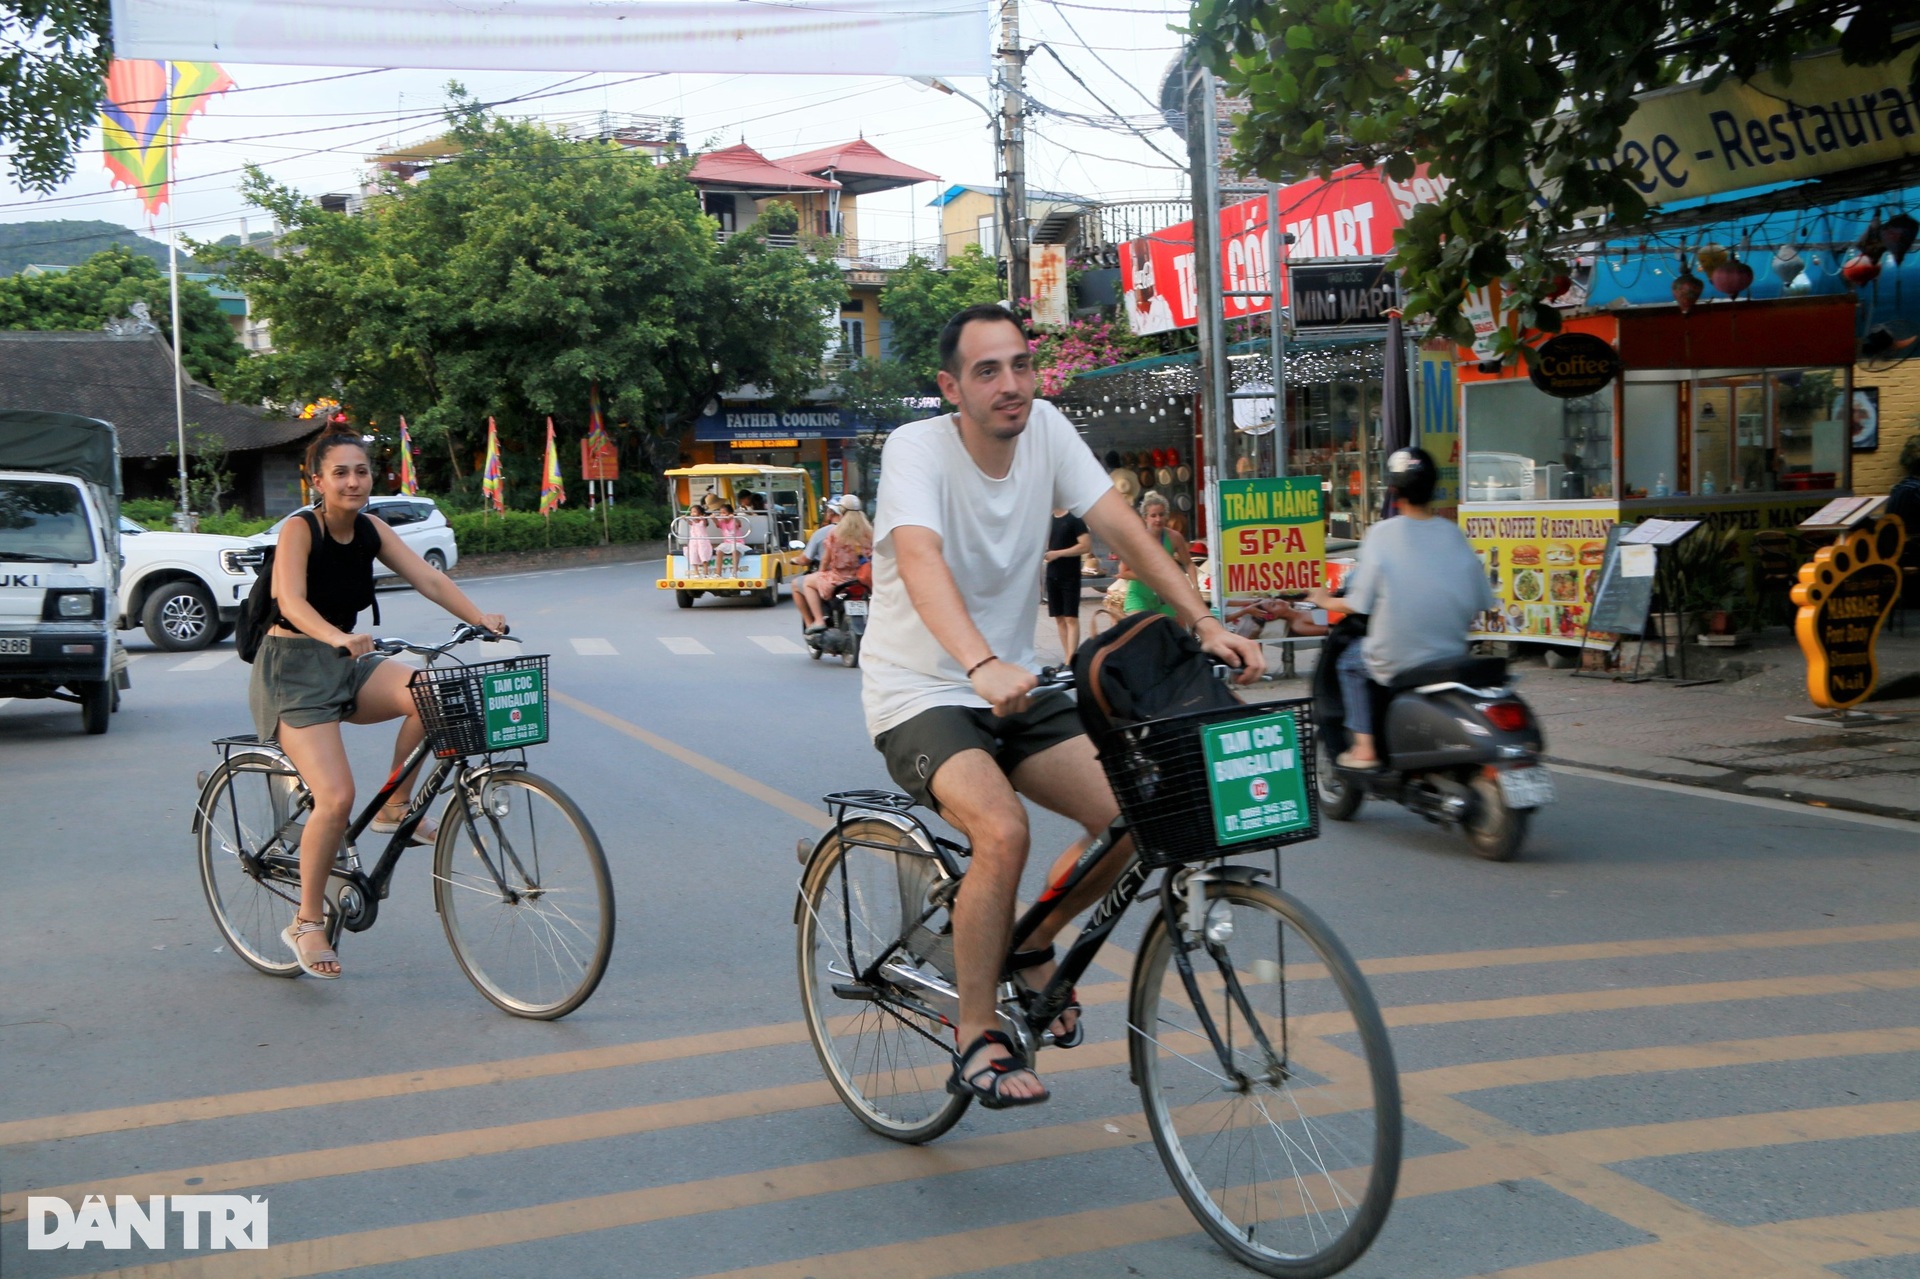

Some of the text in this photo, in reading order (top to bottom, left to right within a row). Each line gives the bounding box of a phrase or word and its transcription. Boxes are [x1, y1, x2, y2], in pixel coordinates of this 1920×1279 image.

[1286, 201, 1375, 259] MART
[1539, 354, 1611, 377] Coffee
[726, 412, 840, 428] FATHER COOKING
[1465, 517, 1497, 539] SEVEN
[1499, 517, 1536, 539] COFFEE
[1239, 527, 1307, 556] SPA
[1228, 560, 1322, 592] MASSAGE
[493, 676, 532, 693] TAM COC
[1832, 673, 1866, 691] Nail
[488, 691, 539, 710] BUNGALOW
[1218, 730, 1251, 755] TAM
[1213, 748, 1294, 782] BUNGALOW
